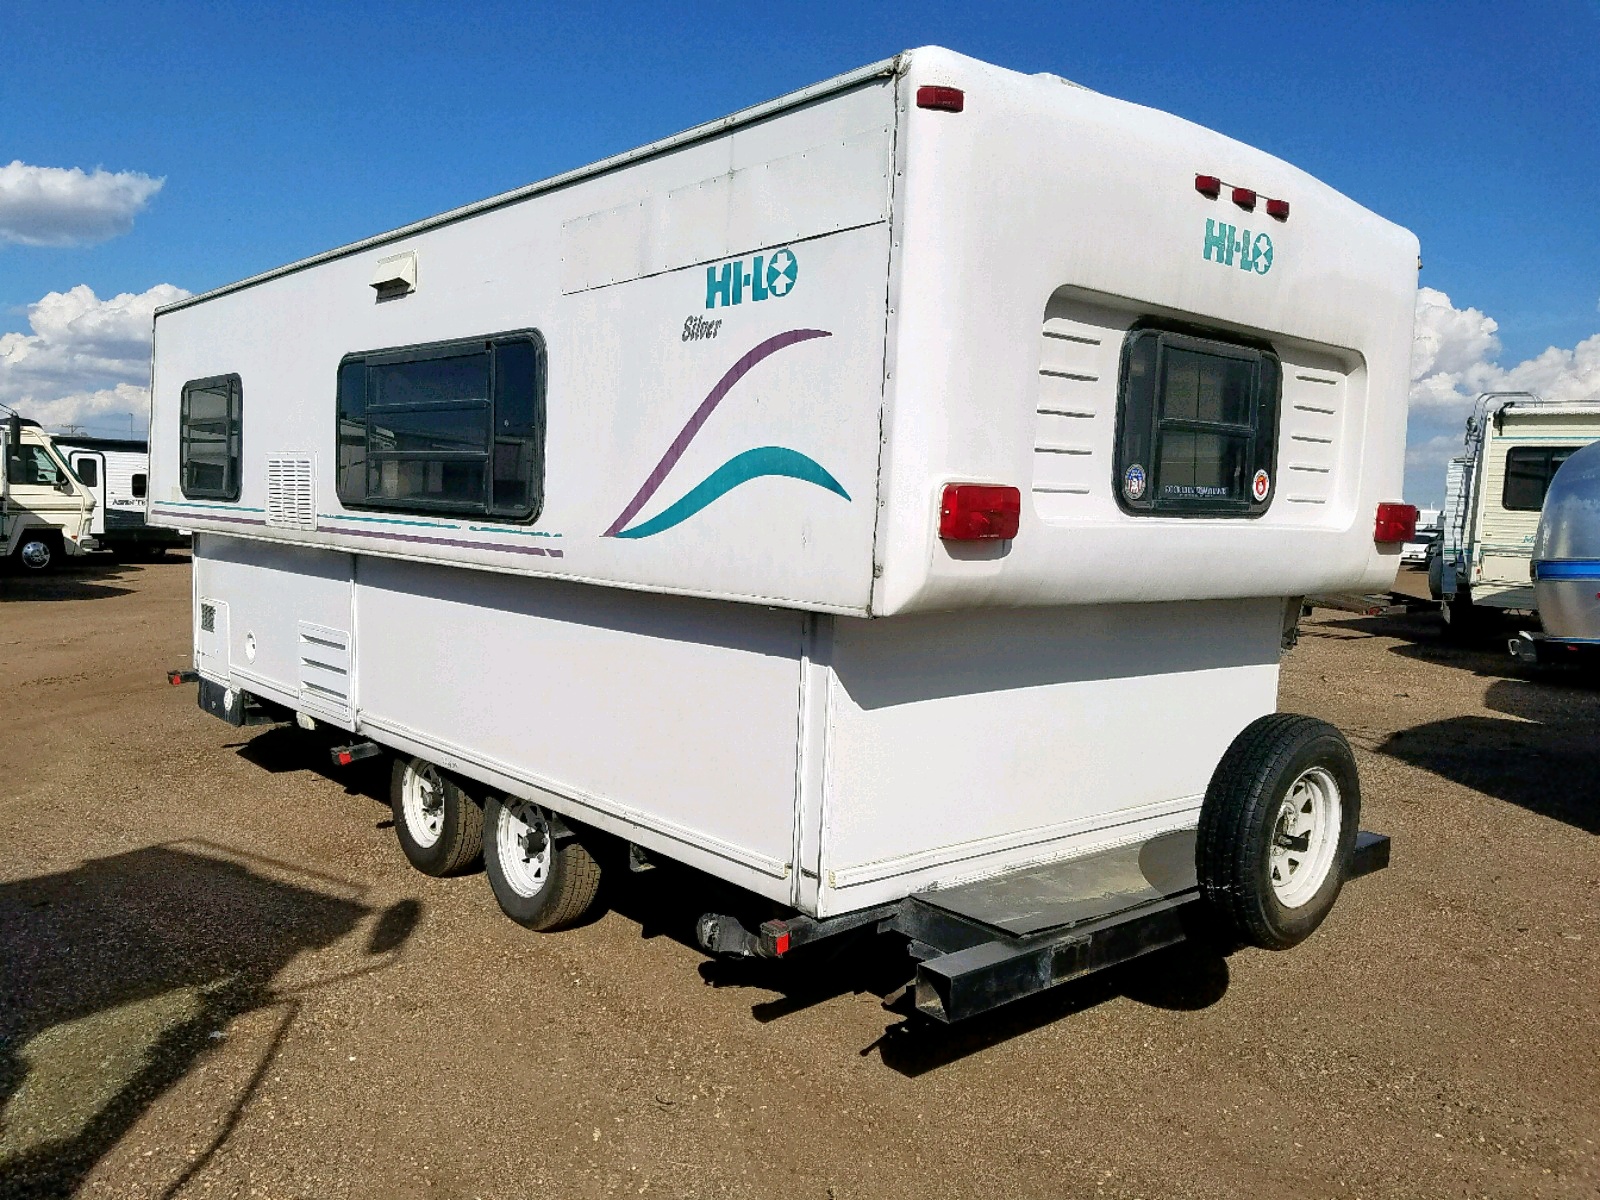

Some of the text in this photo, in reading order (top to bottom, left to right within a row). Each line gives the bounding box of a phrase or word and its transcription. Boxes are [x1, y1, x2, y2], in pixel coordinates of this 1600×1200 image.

[1203, 217, 1273, 275] HI-LO
[706, 248, 798, 309] HI-LO
[682, 315, 722, 342] Silver
